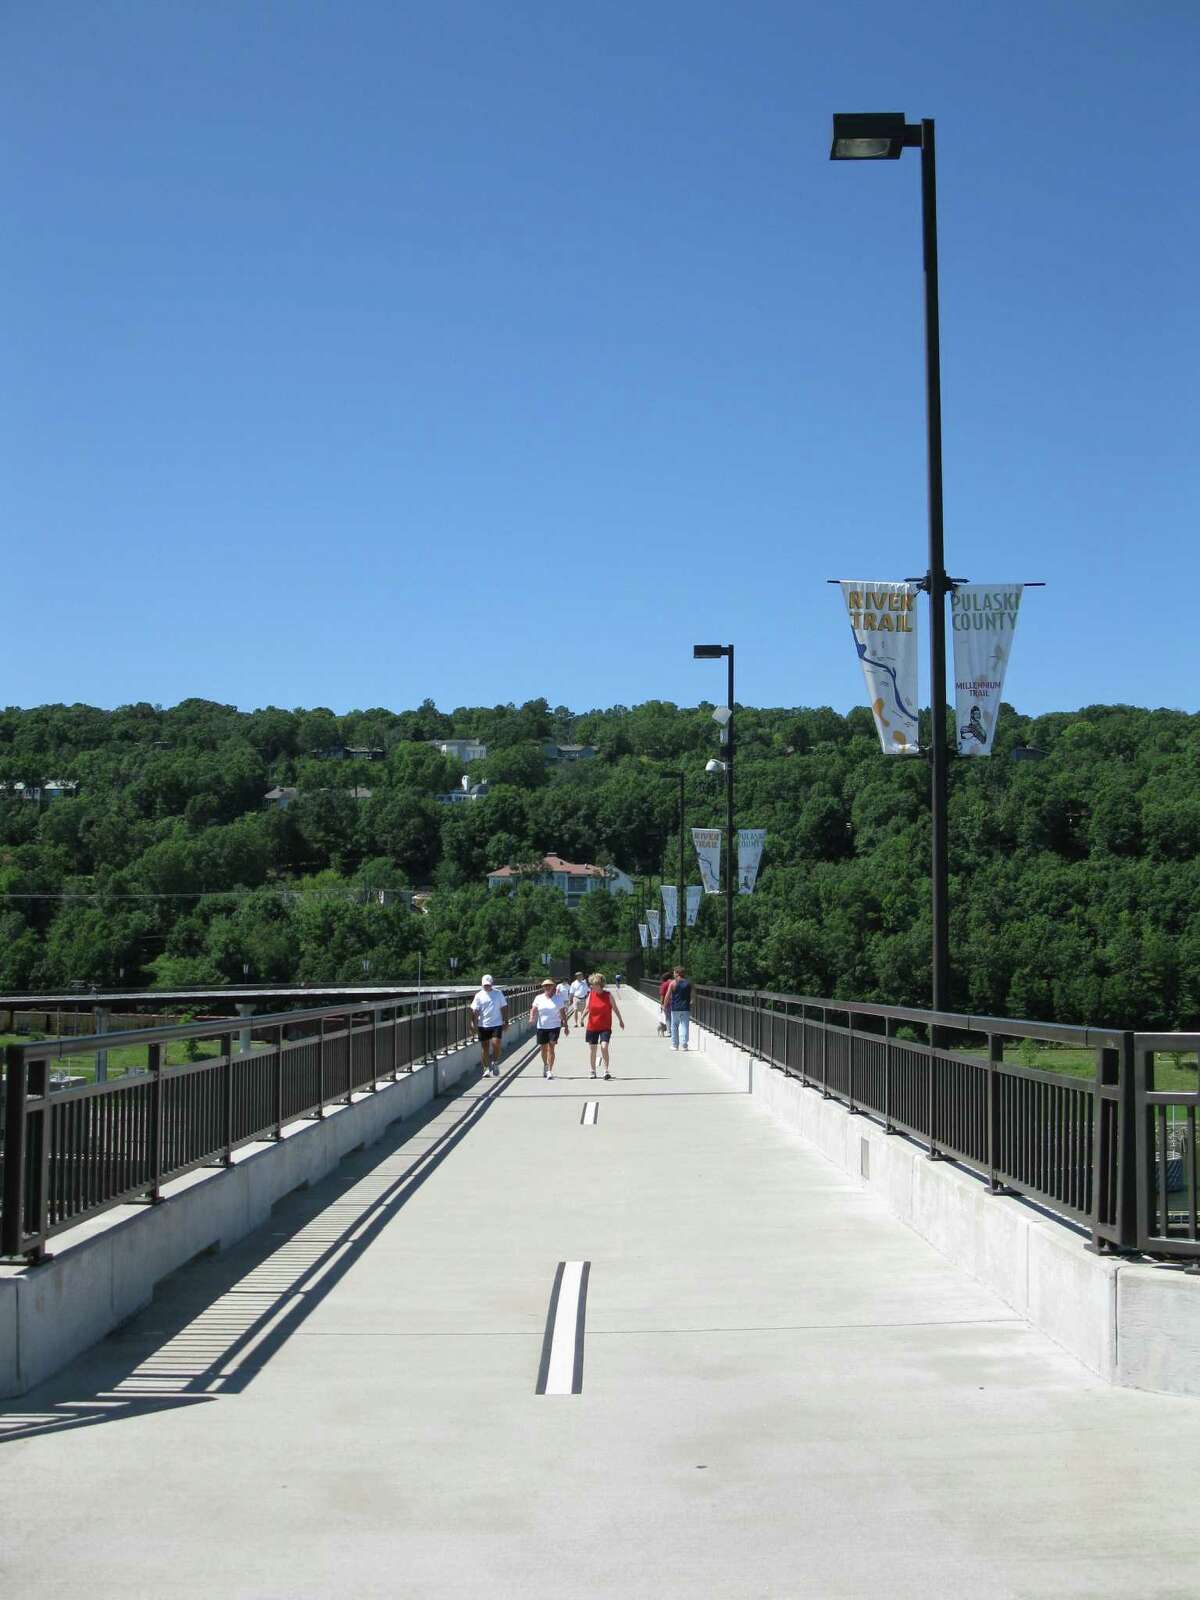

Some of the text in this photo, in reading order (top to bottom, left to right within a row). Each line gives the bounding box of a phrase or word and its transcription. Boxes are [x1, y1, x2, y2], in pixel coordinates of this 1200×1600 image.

[849, 591, 913, 612] RIVER
[952, 592, 1020, 612] PULASKI
[850, 612, 913, 632] TRAIL
[952, 611, 1016, 631] COUNTY
[956, 681, 1001, 690] MILLENNIUM
[969, 689, 990, 697] TRAIL
